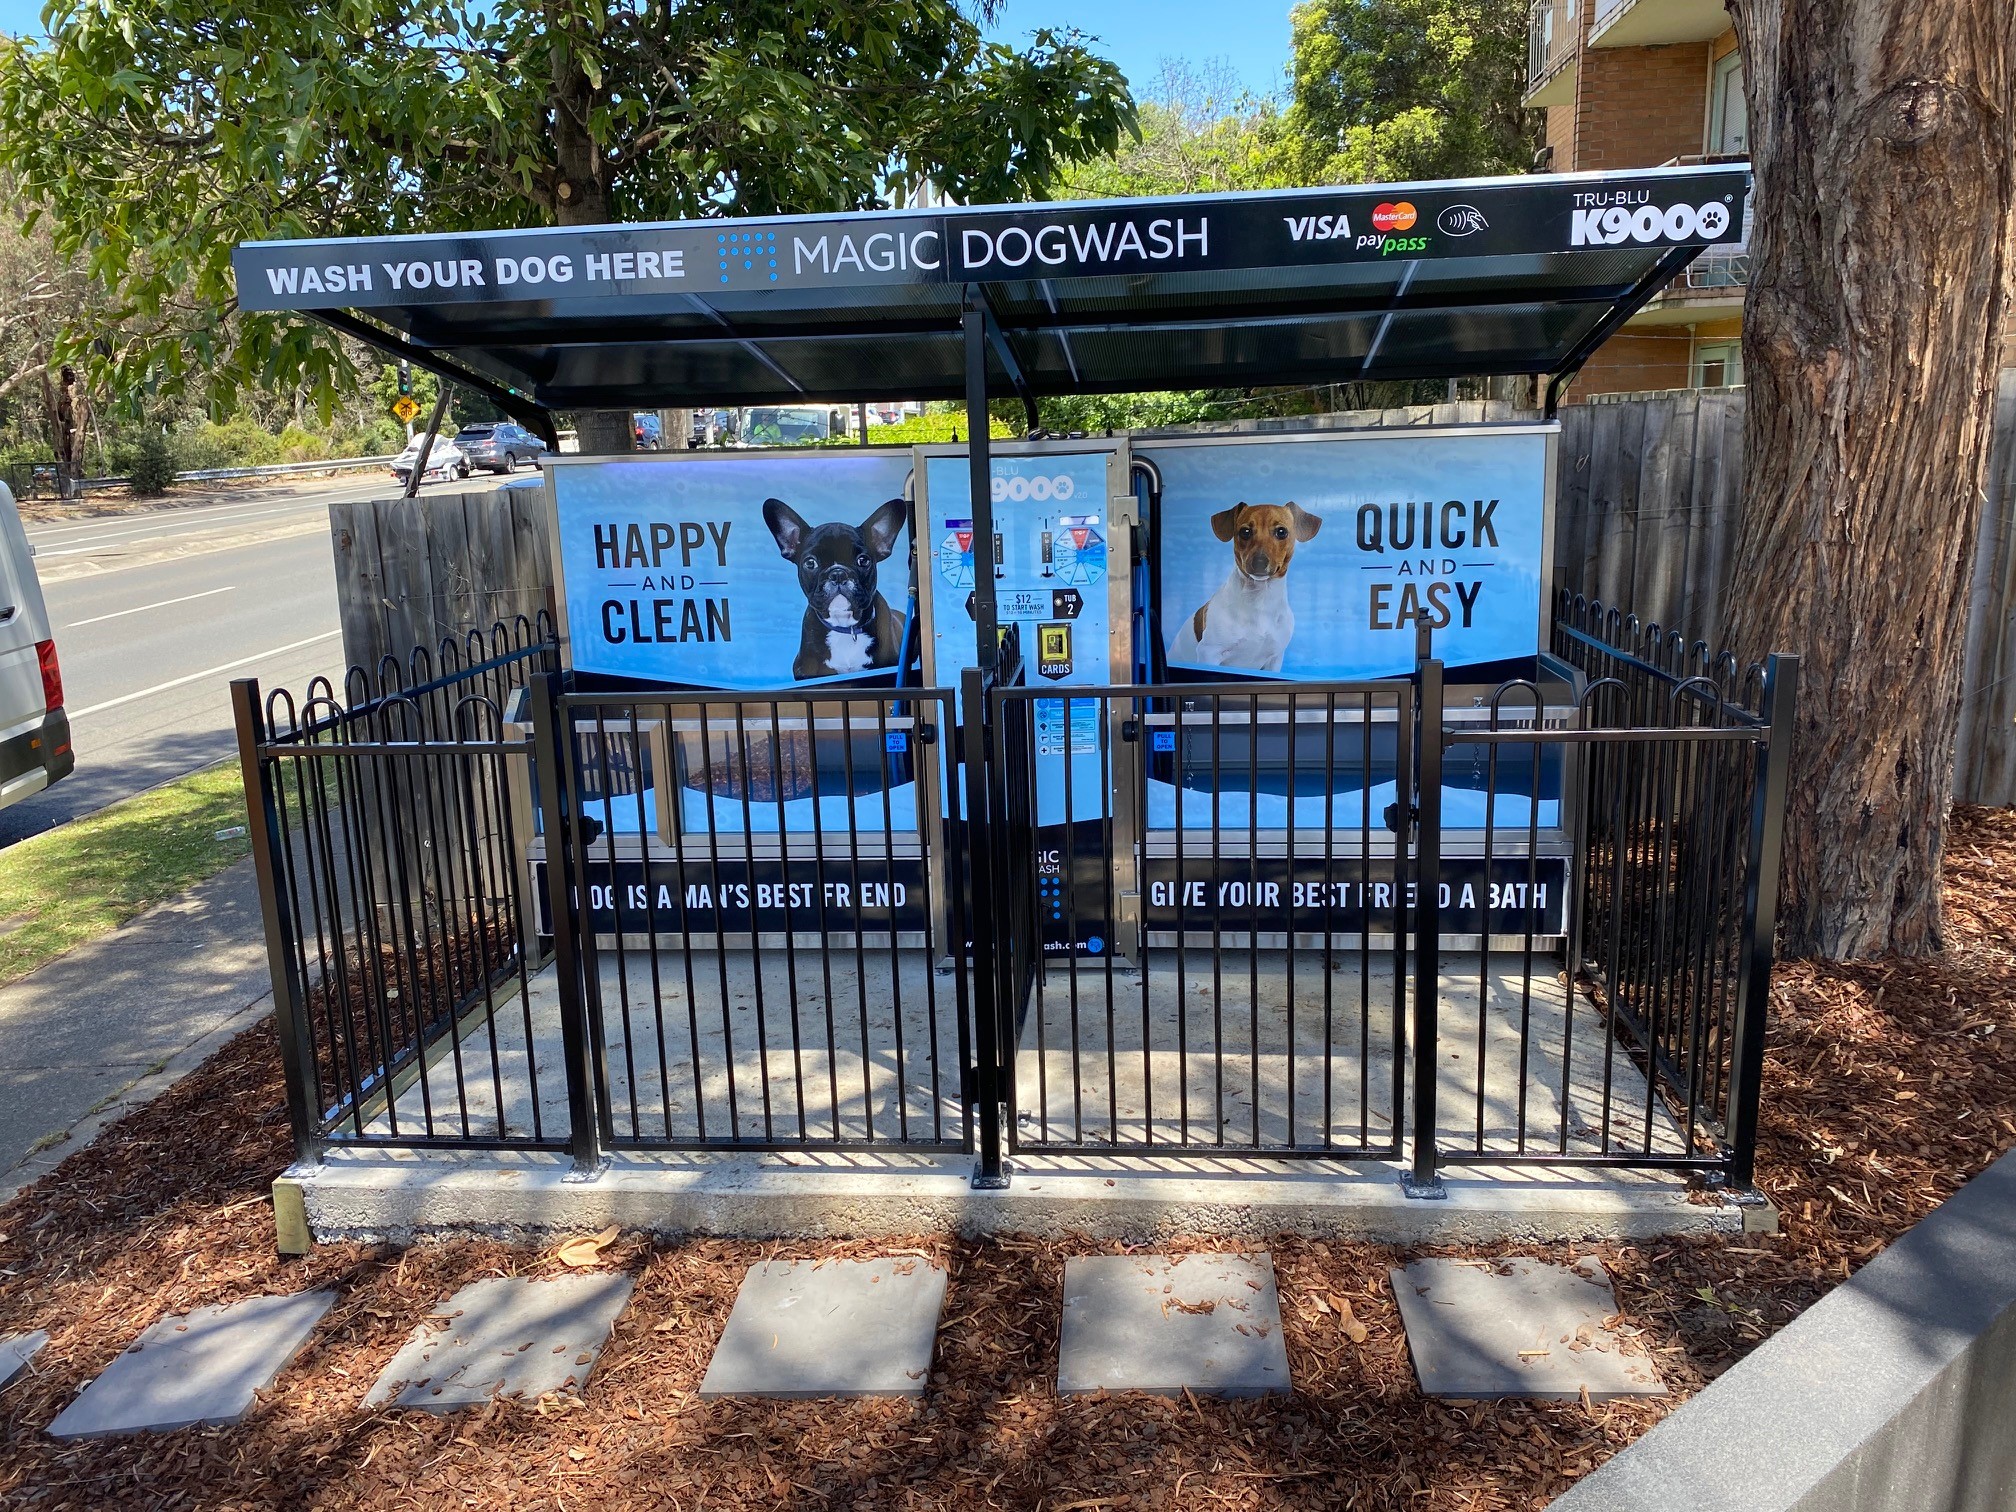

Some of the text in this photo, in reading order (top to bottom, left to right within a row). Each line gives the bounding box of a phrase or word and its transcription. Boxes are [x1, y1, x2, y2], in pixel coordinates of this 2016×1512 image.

[1573, 190, 1650, 207] TRU-BLU
[1283, 214, 1351, 241] VISA
[1373, 210, 1416, 222] MasterCard
[1571, 201, 1730, 246] K9000
[794, 217, 1209, 274] MAGIC DOGWASH
[266, 250, 686, 295] WASH YOUR DOG HERE
[992, 475, 1074, 503] 9000
[1355, 499, 1501, 554] QUICK
[593, 521, 732, 569] HAPPY
[1397, 558, 1457, 576] AND
[641, 575, 695, 592] AND
[1016, 594, 1031, 604] $12
[1064, 594, 1077, 602] TUB
[1067, 603, 1074, 615] 2
[1368, 581, 1483, 631] EASY
[601, 597, 732, 645] CLEAN
[1041, 664, 1070, 674] CARDS
[627, 885, 647, 909] IS
[657, 885, 672, 909] A
[756, 883, 813, 908] BEST
[823, 882, 906, 908] FREND
[1218, 881, 1280, 907] YOUR
[1293, 882, 1350, 908] BEST
[1358, 882, 1450, 908] FRIED
[1459, 883, 1476, 908] A
[1489, 883, 1547, 908] BATH
